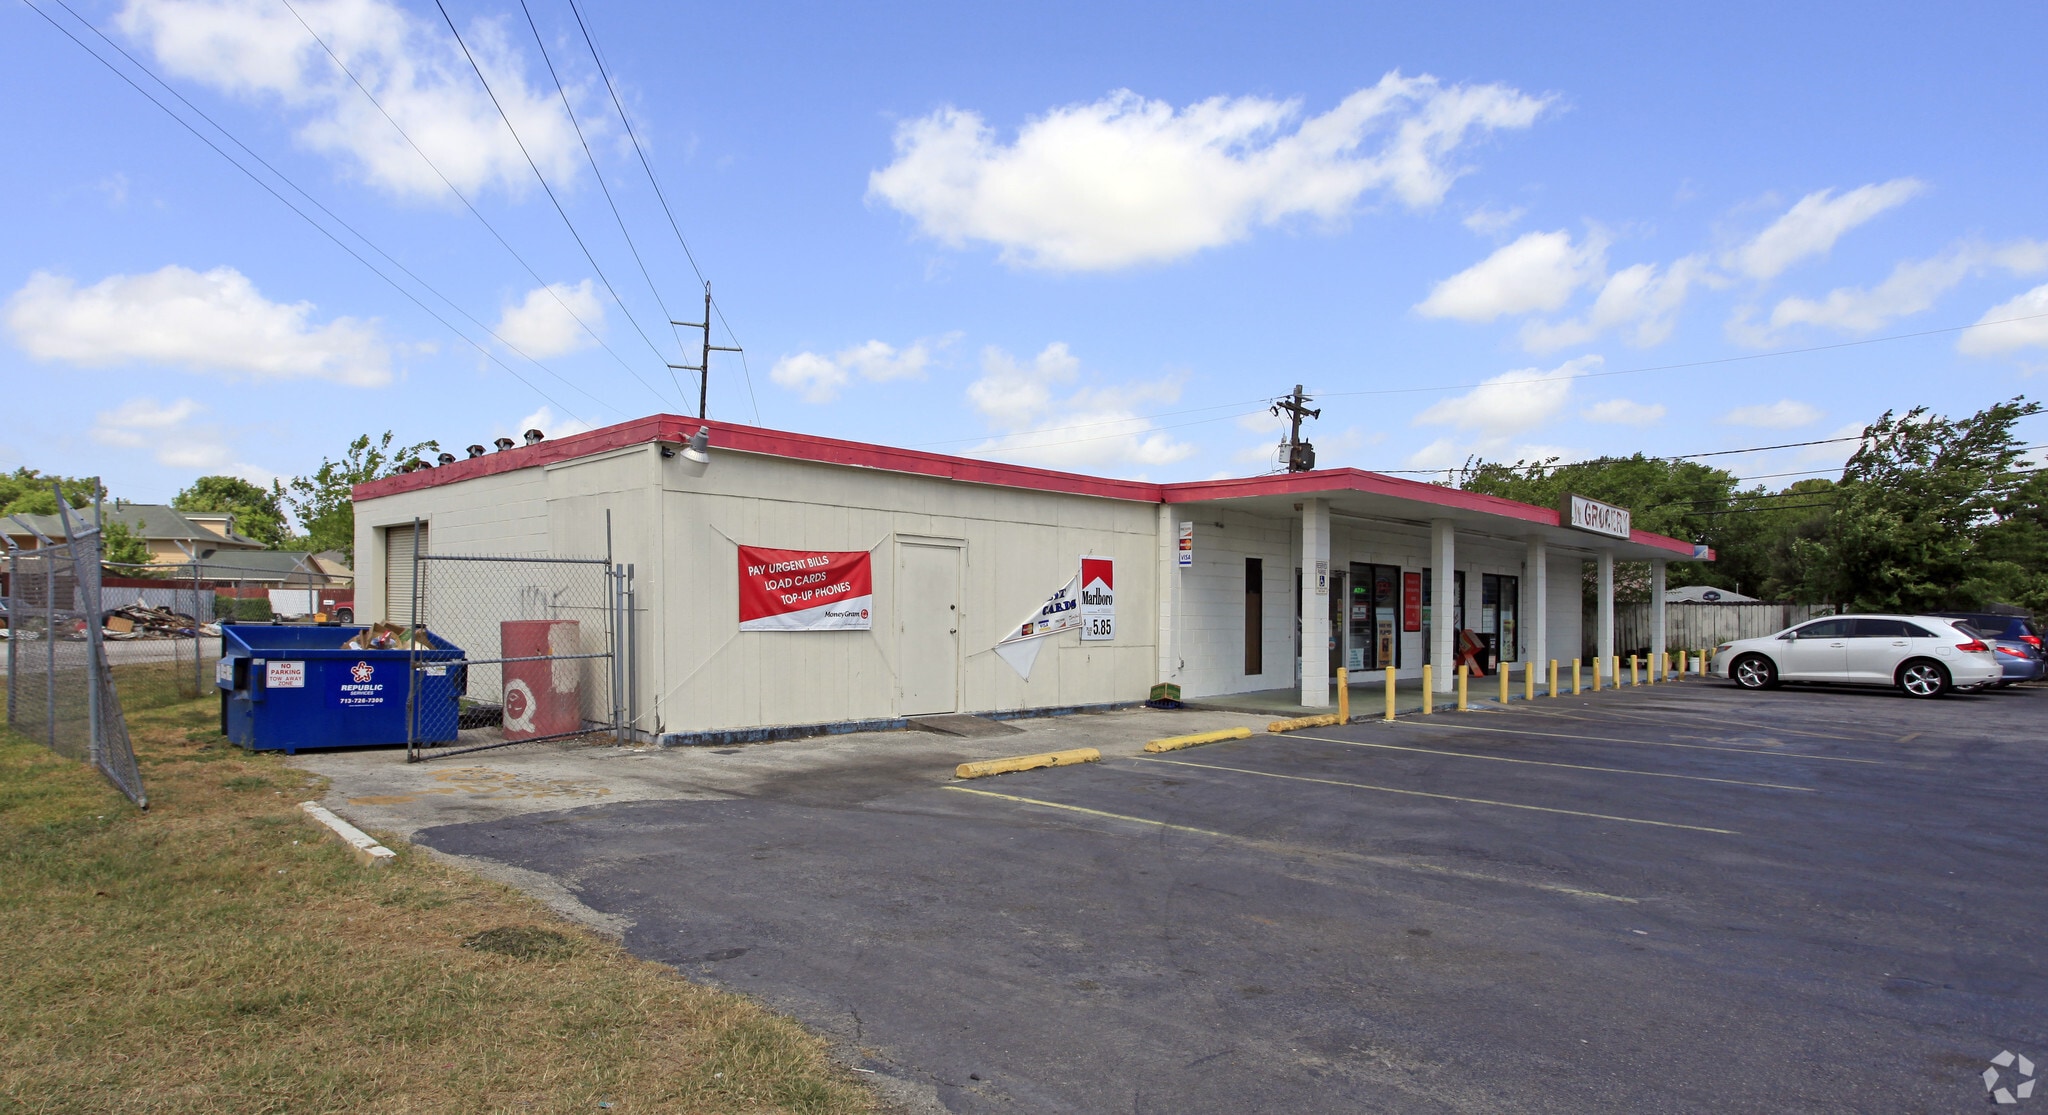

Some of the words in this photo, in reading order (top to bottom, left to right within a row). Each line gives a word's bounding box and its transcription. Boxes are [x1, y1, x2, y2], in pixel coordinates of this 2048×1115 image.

[748, 565, 765, 576] PAY
[768, 559, 805, 574] URGENT
[808, 555, 829, 568] BILLS
[765, 578, 792, 591] LOAD
[794, 571, 827, 586] CARDS
[781, 590, 812, 605] TOP-UP
[815, 581, 851, 597] PHONES
[1082, 588, 1113, 605] Marlboro
[824, 610, 860, 618] MoneyGram
[1042, 599, 1077, 615] CARDS
[1093, 619, 1111, 635] 5.85
